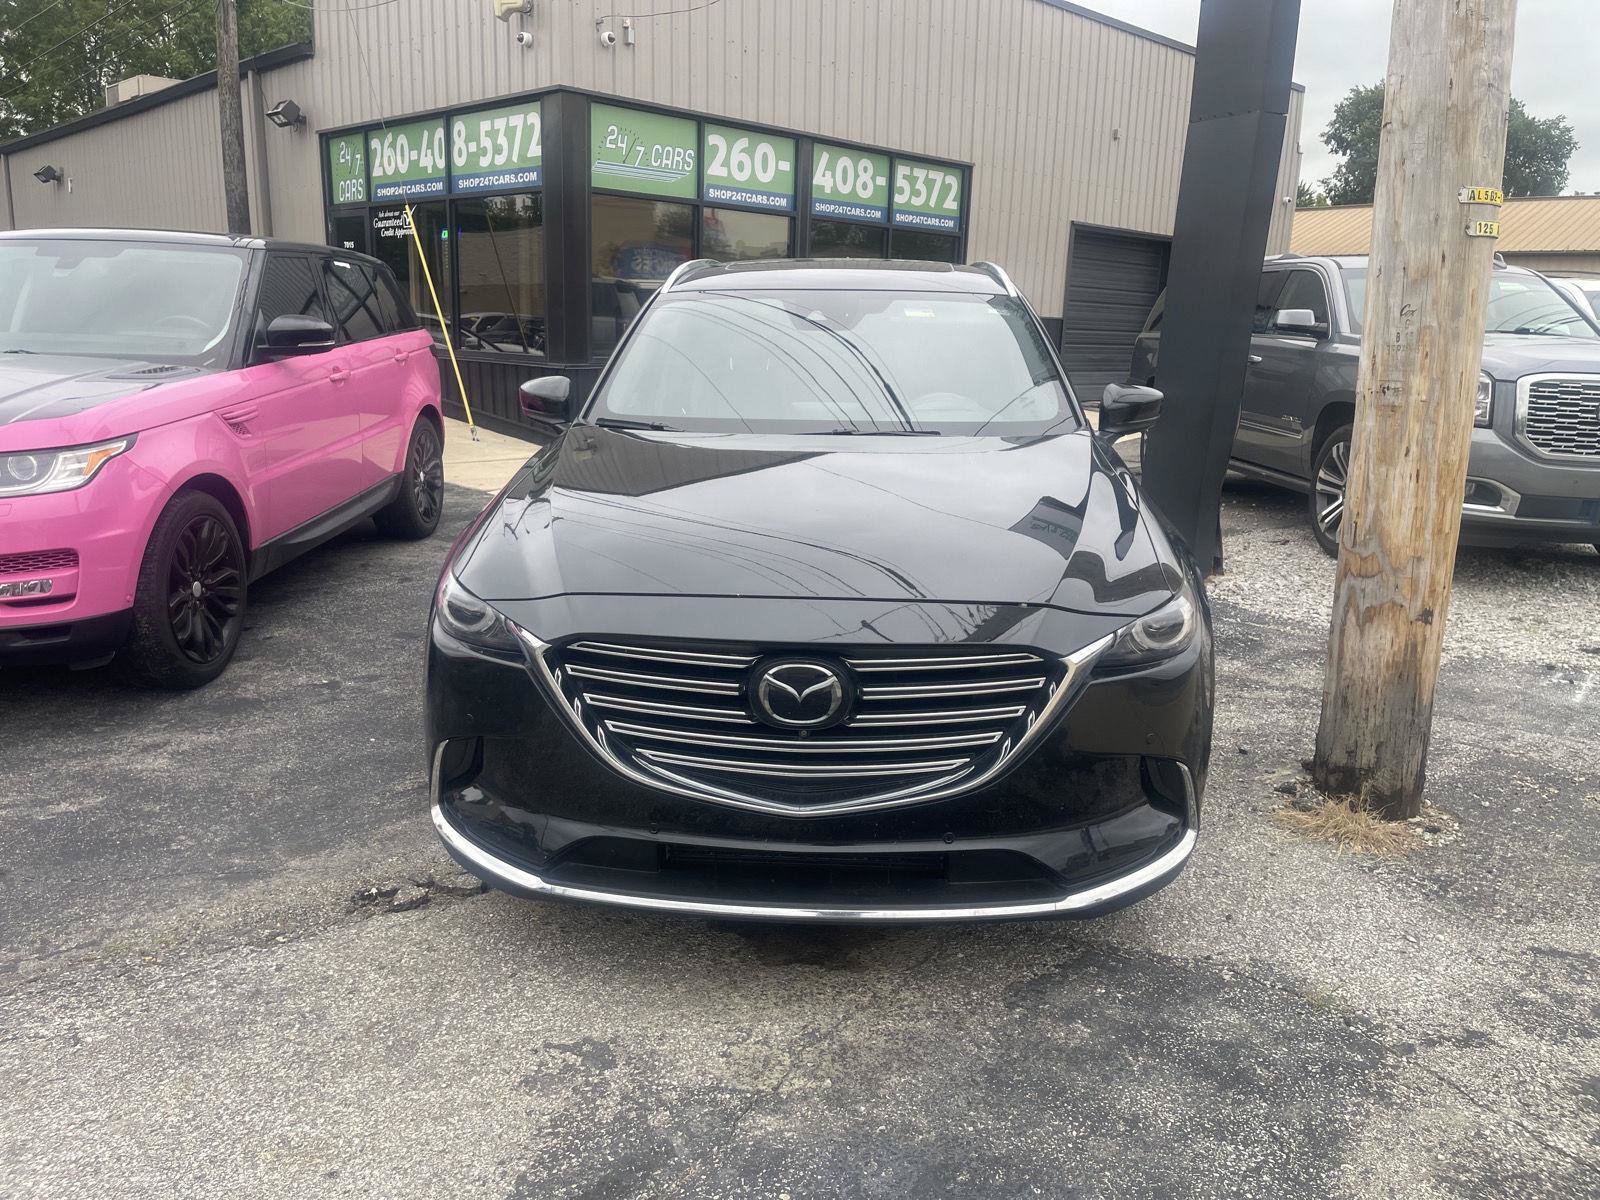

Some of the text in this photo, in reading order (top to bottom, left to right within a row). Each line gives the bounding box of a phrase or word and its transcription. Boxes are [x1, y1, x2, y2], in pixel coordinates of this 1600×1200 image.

[605, 125, 694, 171] 24/7 CARS
[458, 171, 537, 189] SHOP247CARS.COM
[707, 134, 958, 210] 260- 408- 5372
[339, 178, 364, 202] CARS
[377, 181, 443, 197] SHOP247CARS.COM
[708, 189, 787, 207] SHOP247CARS.COM
[815, 202, 882, 219] SHOP247CARS.COM
[374, 215, 403, 228] Guaranteed
[895, 213, 954, 228] SHOP247CARS.COM
[380, 228, 394, 238] Credit
